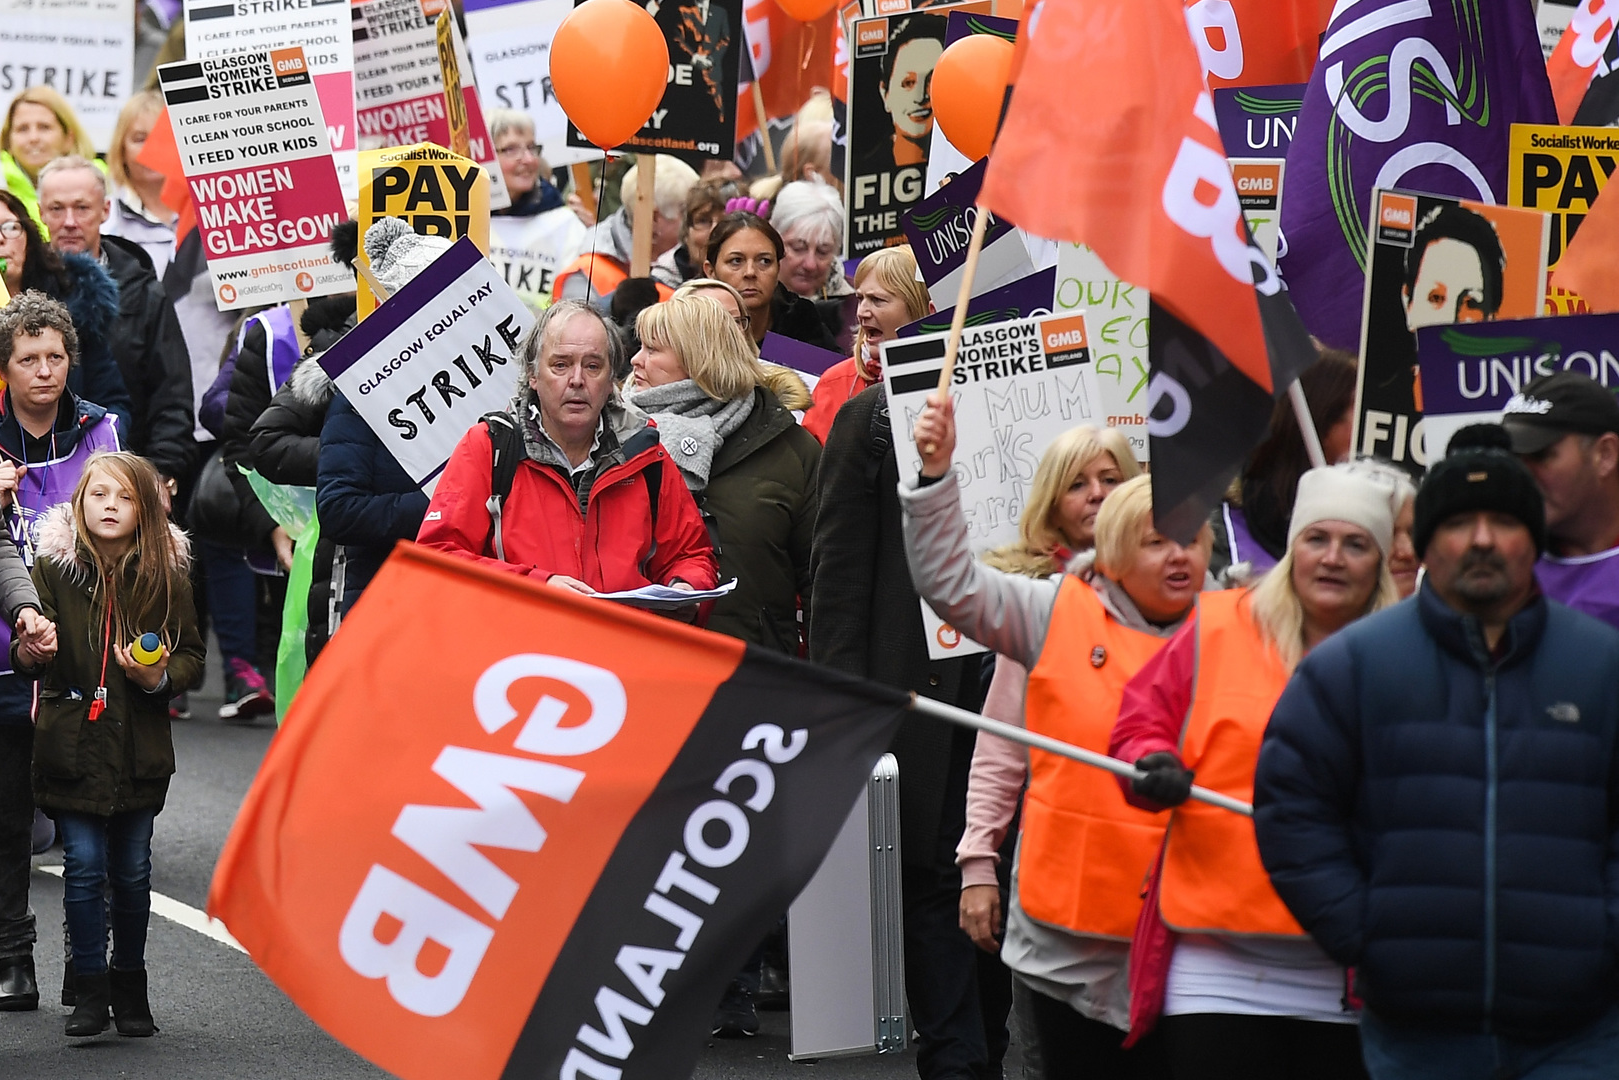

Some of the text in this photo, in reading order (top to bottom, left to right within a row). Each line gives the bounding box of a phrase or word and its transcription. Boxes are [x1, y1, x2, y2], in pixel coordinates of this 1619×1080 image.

[367, 6, 420, 25] WOMEN'S
[370, 15, 423, 38] STRIKE
[204, 31, 230, 41] CARE
[235, 27, 255, 36] FOR
[259, 24, 287, 34] YOUR
[291, 18, 338, 29] PARENTS
[203, 52, 303, 72] GLASGOW GMB
[206, 64, 272, 84] WOMEN'S
[1, 64, 119, 97] STRIKE
[209, 76, 277, 99] STRIKE
[363, 77, 429, 98] FEED YOUR
[497, 76, 558, 109] STR
[185, 113, 211, 125] CARE
[213, 109, 233, 119] FOR
[235, 105, 262, 117] YOUR
[264, 99, 308, 112] PARENTS
[358, 98, 444, 134] WOMEN
[191, 129, 229, 144] CLEAN
[232, 123, 264, 137] YOUR
[267, 117, 315, 131] SCHOOL
[388, 126, 429, 146] AKE
[1531, 133, 1619, 150] Socialist Worke
[198, 149, 234, 165] FEED
[238, 142, 279, 159] YOUR
[283, 136, 318, 152] KIDS
[191, 166, 294, 203] WOMEN
[371, 164, 481, 213] PAY
[854, 168, 922, 210] FIG
[1238, 178, 1273, 190] GMB
[199, 196, 277, 229] MAKE
[854, 212, 897, 234] THE
[1383, 207, 1411, 224] GMB
[207, 212, 339, 255] GLASGOW
[925, 204, 995, 265] UNISO
[358, 281, 495, 396] GLASGOW EQUAL PAY
[955, 323, 1082, 348] LASGOW GMB
[955, 338, 1040, 365] WOMEN'S
[387, 313, 522, 440] STRIKE
[954, 354, 1044, 385] STRIKE
